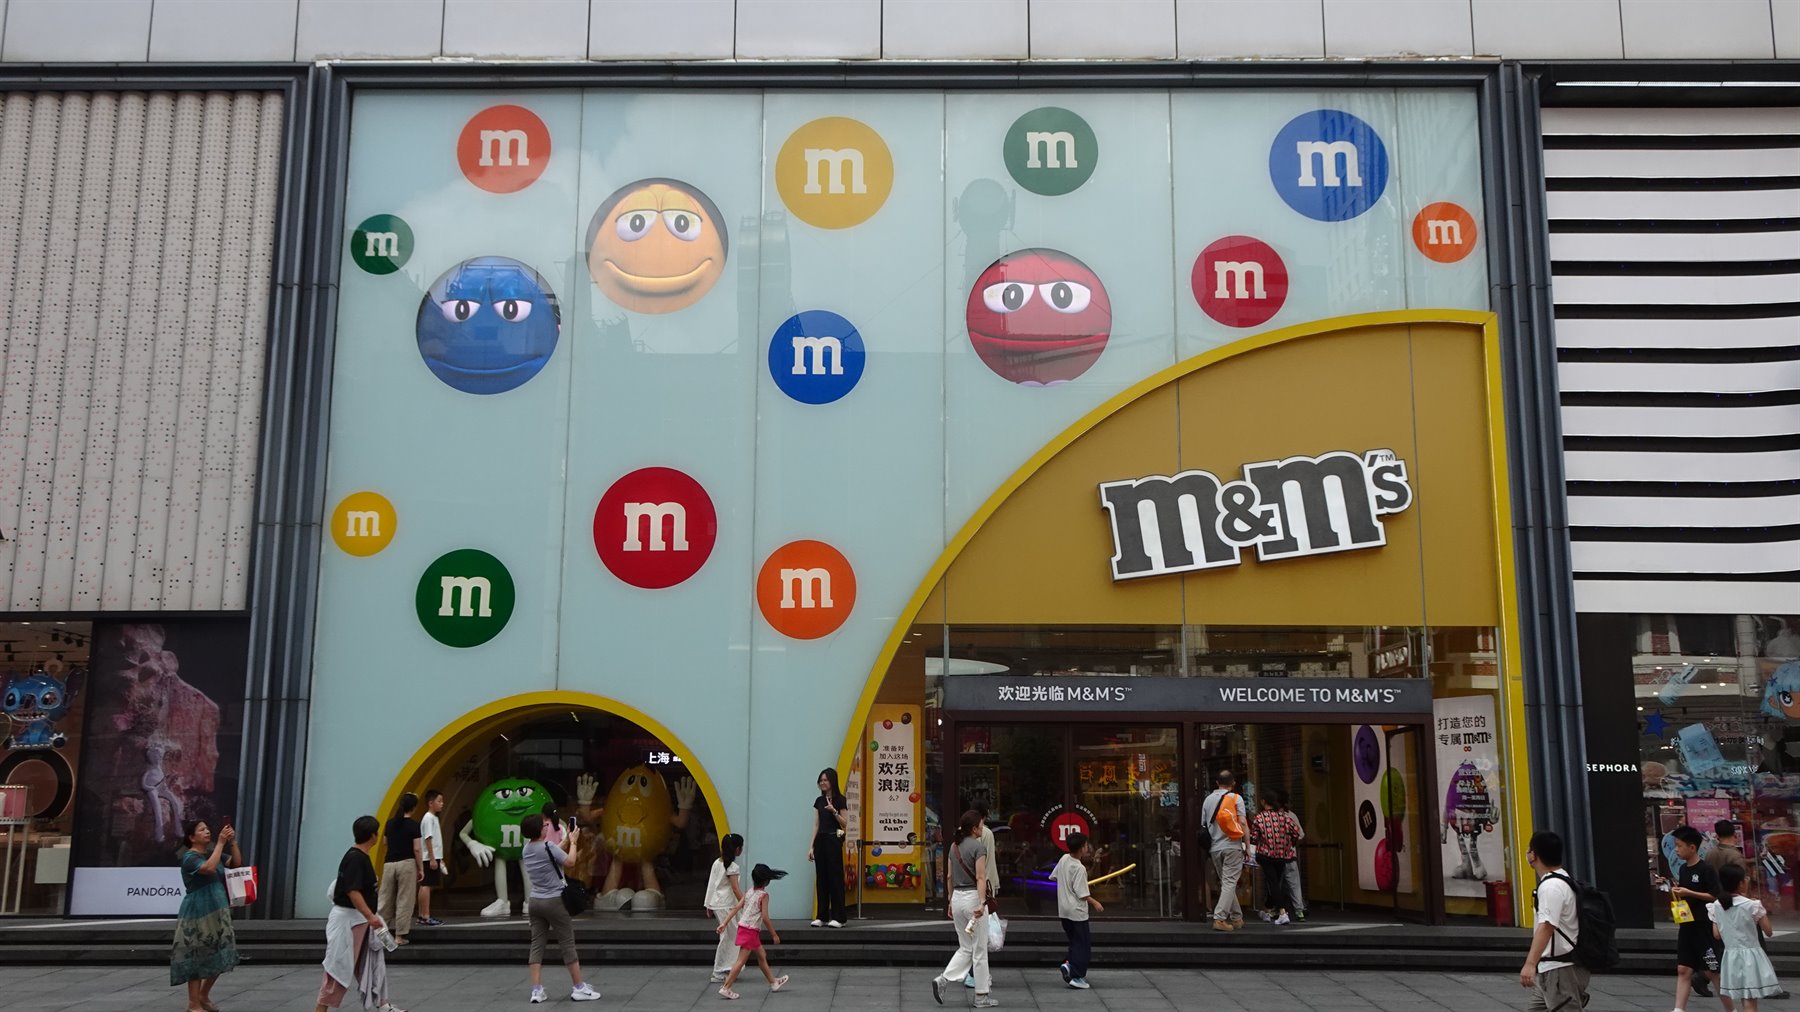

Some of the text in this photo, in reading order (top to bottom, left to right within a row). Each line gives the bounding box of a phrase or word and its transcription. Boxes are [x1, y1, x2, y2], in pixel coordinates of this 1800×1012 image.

[479, 128, 530, 167] m
[1026, 131, 1078, 169] m
[803, 147, 868, 194] m
[1296, 139, 1363, 188] m
[364, 230, 400, 257] m
[1428, 218, 1463, 245] m
[1213, 260, 1267, 299] m
[790, 335, 844, 375] m
[345, 510, 381, 537] m
[623, 501, 689, 552] m
[437, 575, 492, 618] m
[779, 567, 834, 609] m
[998, 685, 1064, 702] 欢迎光临
[1219, 687, 1306, 702] WELCOME
[1309, 687, 1332, 703] TO
[1437, 715, 1487, 731] 打造您的
[1438, 732, 1462, 746] 专属
[648, 751, 670, 765] 上海
[877, 762, 910, 776] 欢乐
[1586, 763, 1638, 773] SEPHORA
[877, 778, 910, 792] 浪潮
